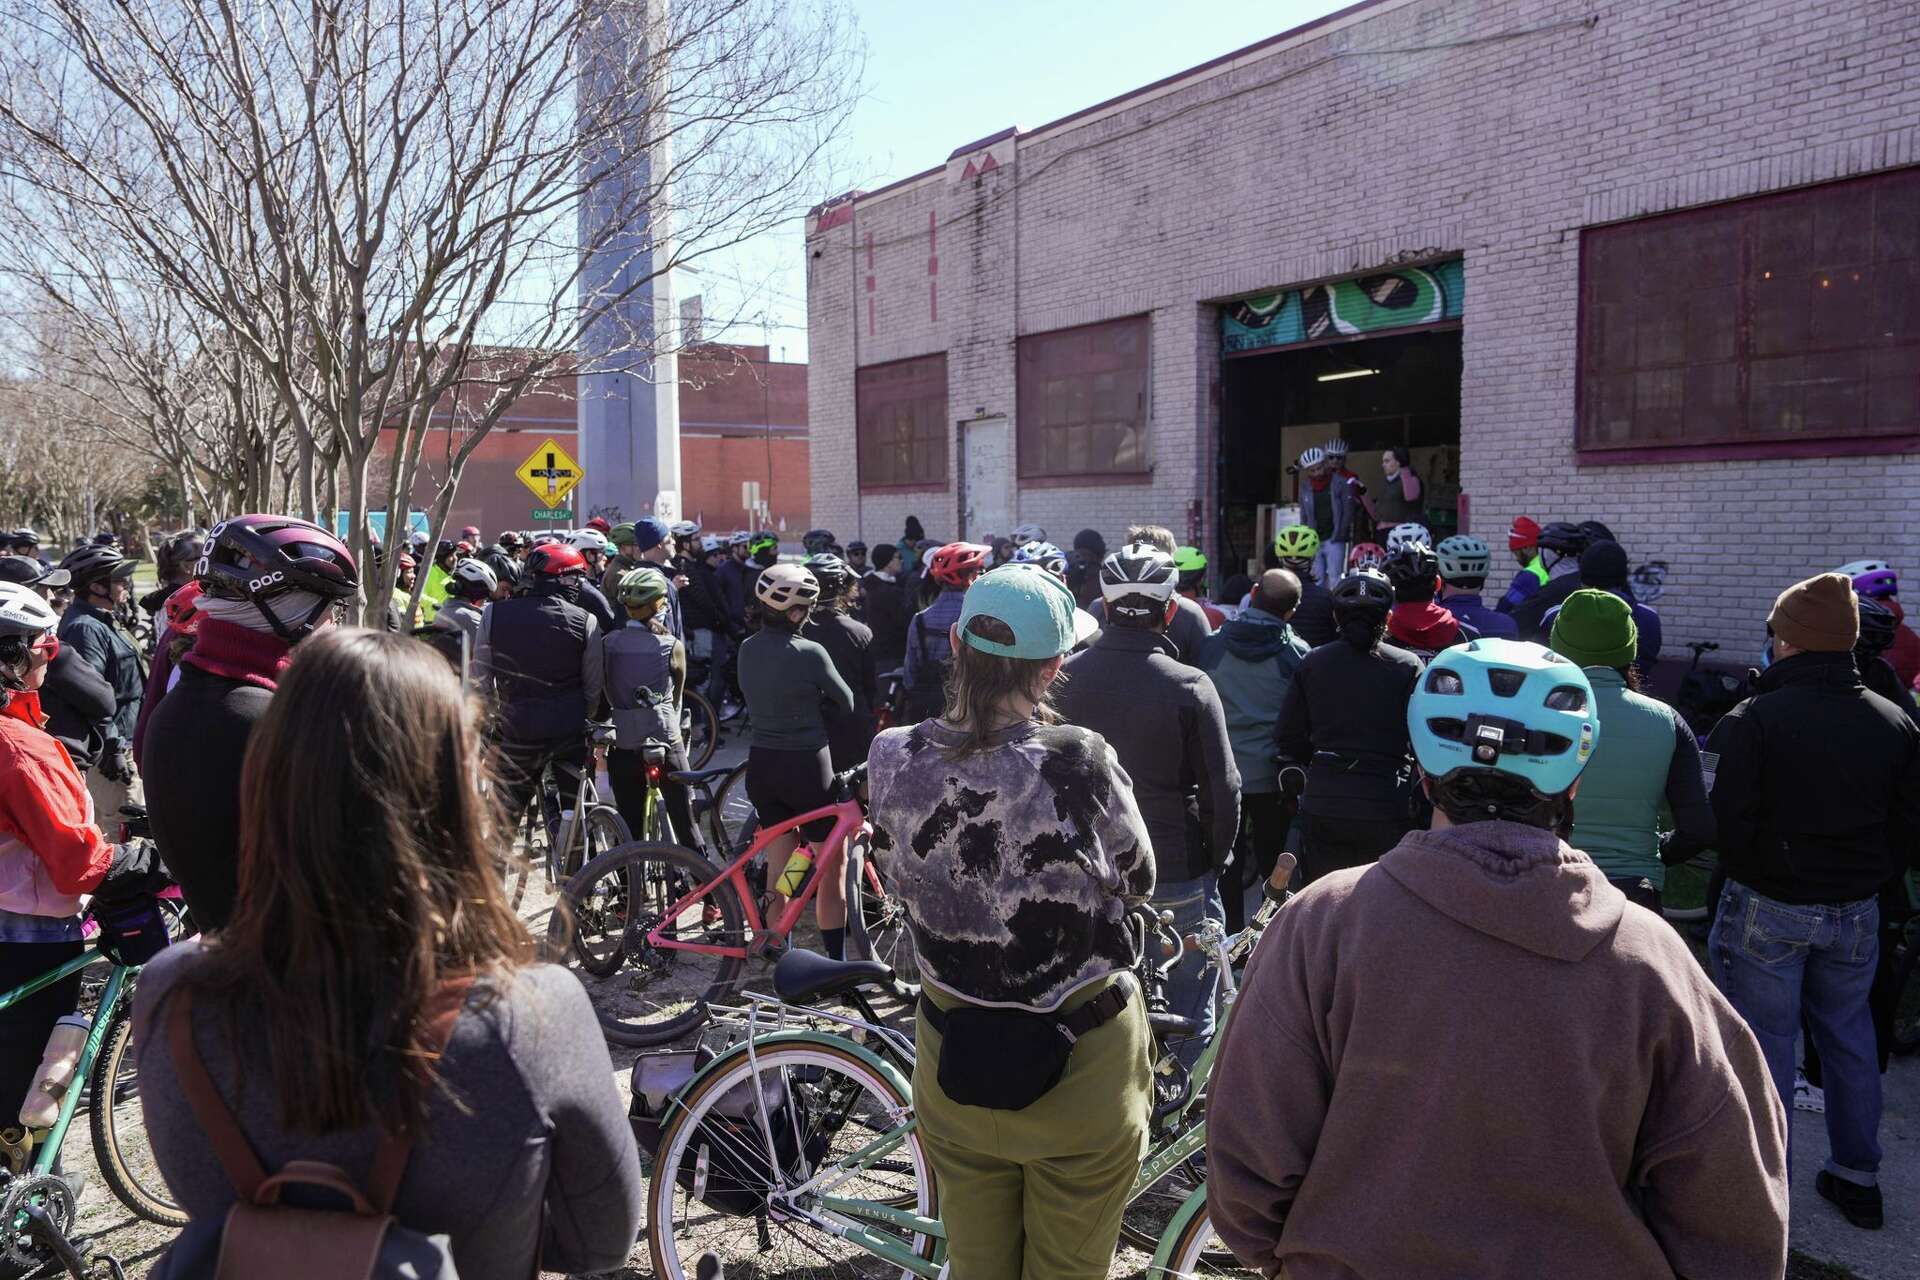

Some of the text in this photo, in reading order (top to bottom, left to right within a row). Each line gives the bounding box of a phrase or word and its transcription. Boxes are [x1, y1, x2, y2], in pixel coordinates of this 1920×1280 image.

[533, 510, 562, 519] CHARLES
[249, 570, 285, 593] POC
[3, 609, 29, 622] SMITH
[856, 1205, 897, 1221] VENUS
